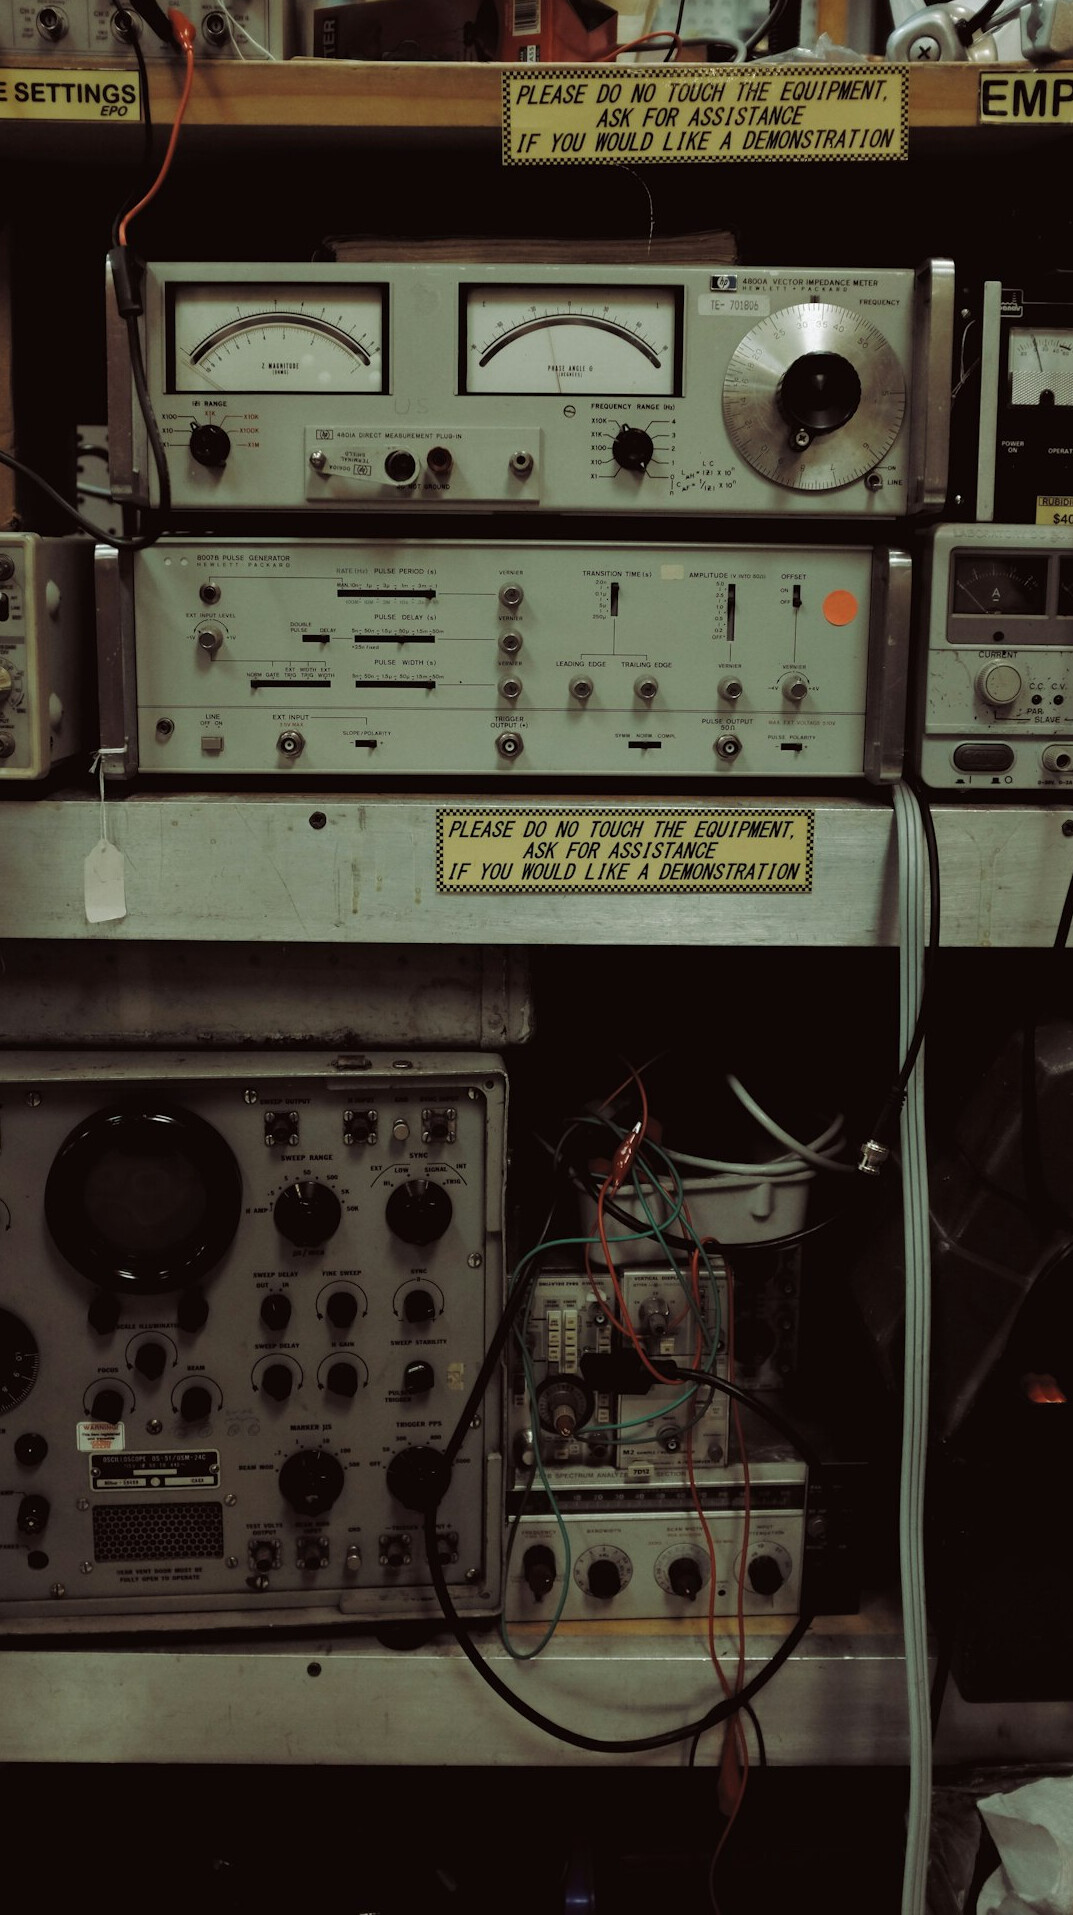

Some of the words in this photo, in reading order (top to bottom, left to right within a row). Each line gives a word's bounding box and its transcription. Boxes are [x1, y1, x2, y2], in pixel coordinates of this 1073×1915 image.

[14, 82, 136, 104] SETTINGS
[516, 84, 589, 104] PLEASE
[597, 84, 622, 103] DO
[631, 83, 657, 102] NO
[668, 82, 727, 102] TOUCH
[738, 81, 773, 101] THE
[781, 81, 888, 101] EQUIPMENT,
[983, 80, 1073, 116] EMP
[100, 106, 128, 116] EPO
[596, 108, 634, 128] ASK
[644, 107, 680, 127] FOR
[687, 106, 805, 126] ASSISTANCE
[516, 134, 543, 153] IF
[552, 133, 586, 152] YOU
[594, 132, 654, 151] WOULD
[663, 131, 711, 150] LIKE
[719, 131, 733, 149] A
[742, 128, 895, 149] DEMONSTRATION
[711, 301, 725, 309] TE-
[730, 301, 758, 310] 701806
[992, 588, 1000, 597] A
[1034, 716, 1060, 724] SLAVE
[448, 820, 515, 838] PLEASE
[523, 820, 547, 838] DO
[555, 820, 580, 838] NO
[590, 821, 642, 838] TOUCH
[654, 821, 686, 839] THE
[694, 821, 794, 840] EQUIPMENT,
[523, 842, 556, 859] ASK
[566, 842, 598, 859] FOR
[608, 842, 718, 859] ASSISTANCE
[448, 863, 471, 879] IF
[480, 863, 513, 880] YOU
[521, 863, 576, 880] WOULD
[585, 863, 629, 880] LIKE
[638, 863, 649, 880] A
[659, 863, 800, 881] DEMONSTRATION
